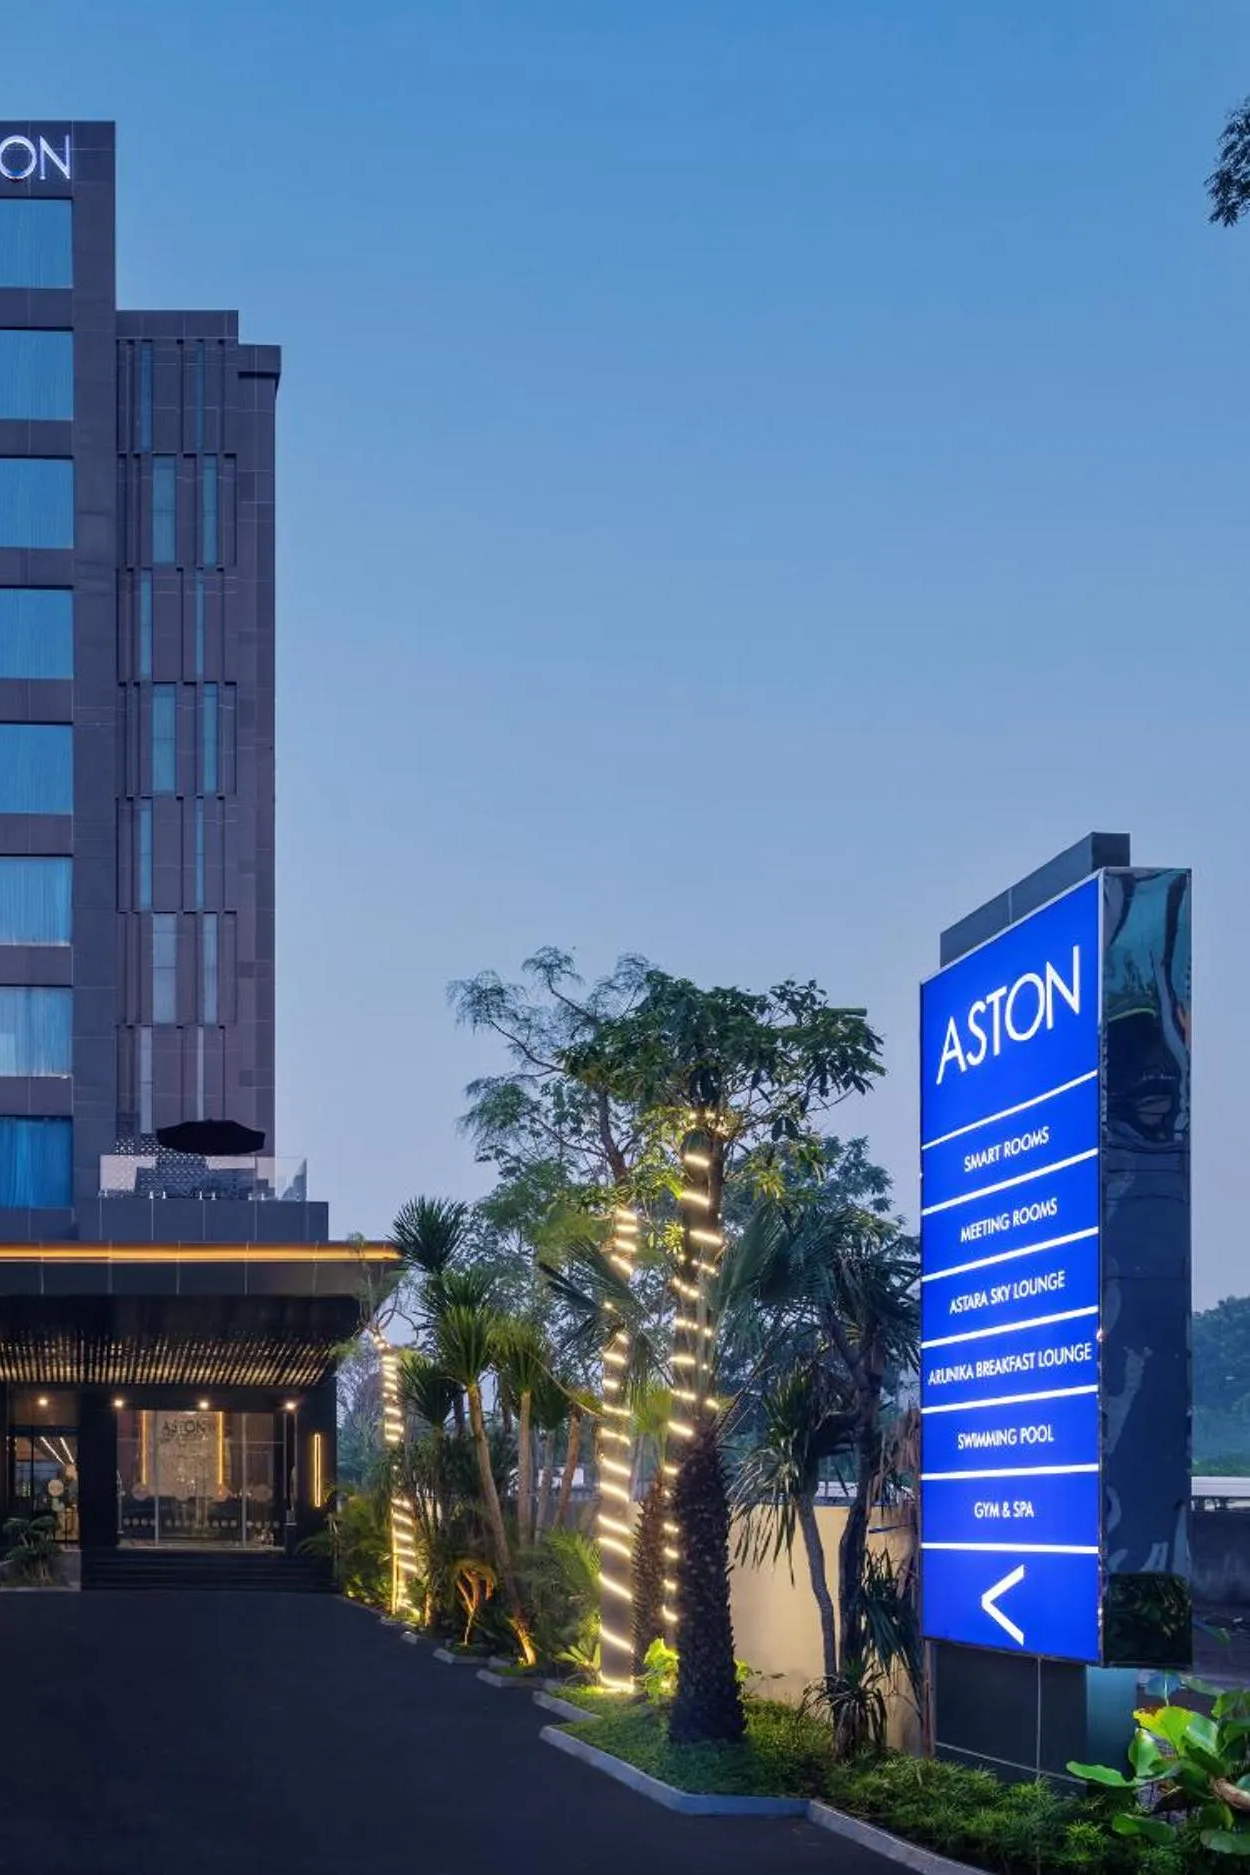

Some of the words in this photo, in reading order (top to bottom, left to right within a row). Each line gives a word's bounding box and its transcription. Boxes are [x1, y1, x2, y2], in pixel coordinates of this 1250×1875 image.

[937, 946, 1080, 1085] ASTON
[964, 1144, 1002, 1173] SMART
[1003, 1126, 1050, 1158] ROOMS
[960, 1213, 1011, 1243] MEETING
[1012, 1198, 1058, 1227] ROOMS
[949, 1290, 989, 1314] ASTARA
[990, 1284, 1011, 1305] SKY
[1012, 1270, 1066, 1300] LOUNGE
[928, 1363, 974, 1386] ARUNIKA
[976, 1352, 1036, 1379] BREAKFAST
[1037, 1342, 1093, 1367] LOUNGE
[957, 1428, 1018, 1450] SWIMMING
[1019, 1424, 1054, 1445] POOL
[974, 1502, 1000, 1519] GYM
[1002, 1501, 1012, 1518] &
[1013, 1500, 1035, 1518] SPA
